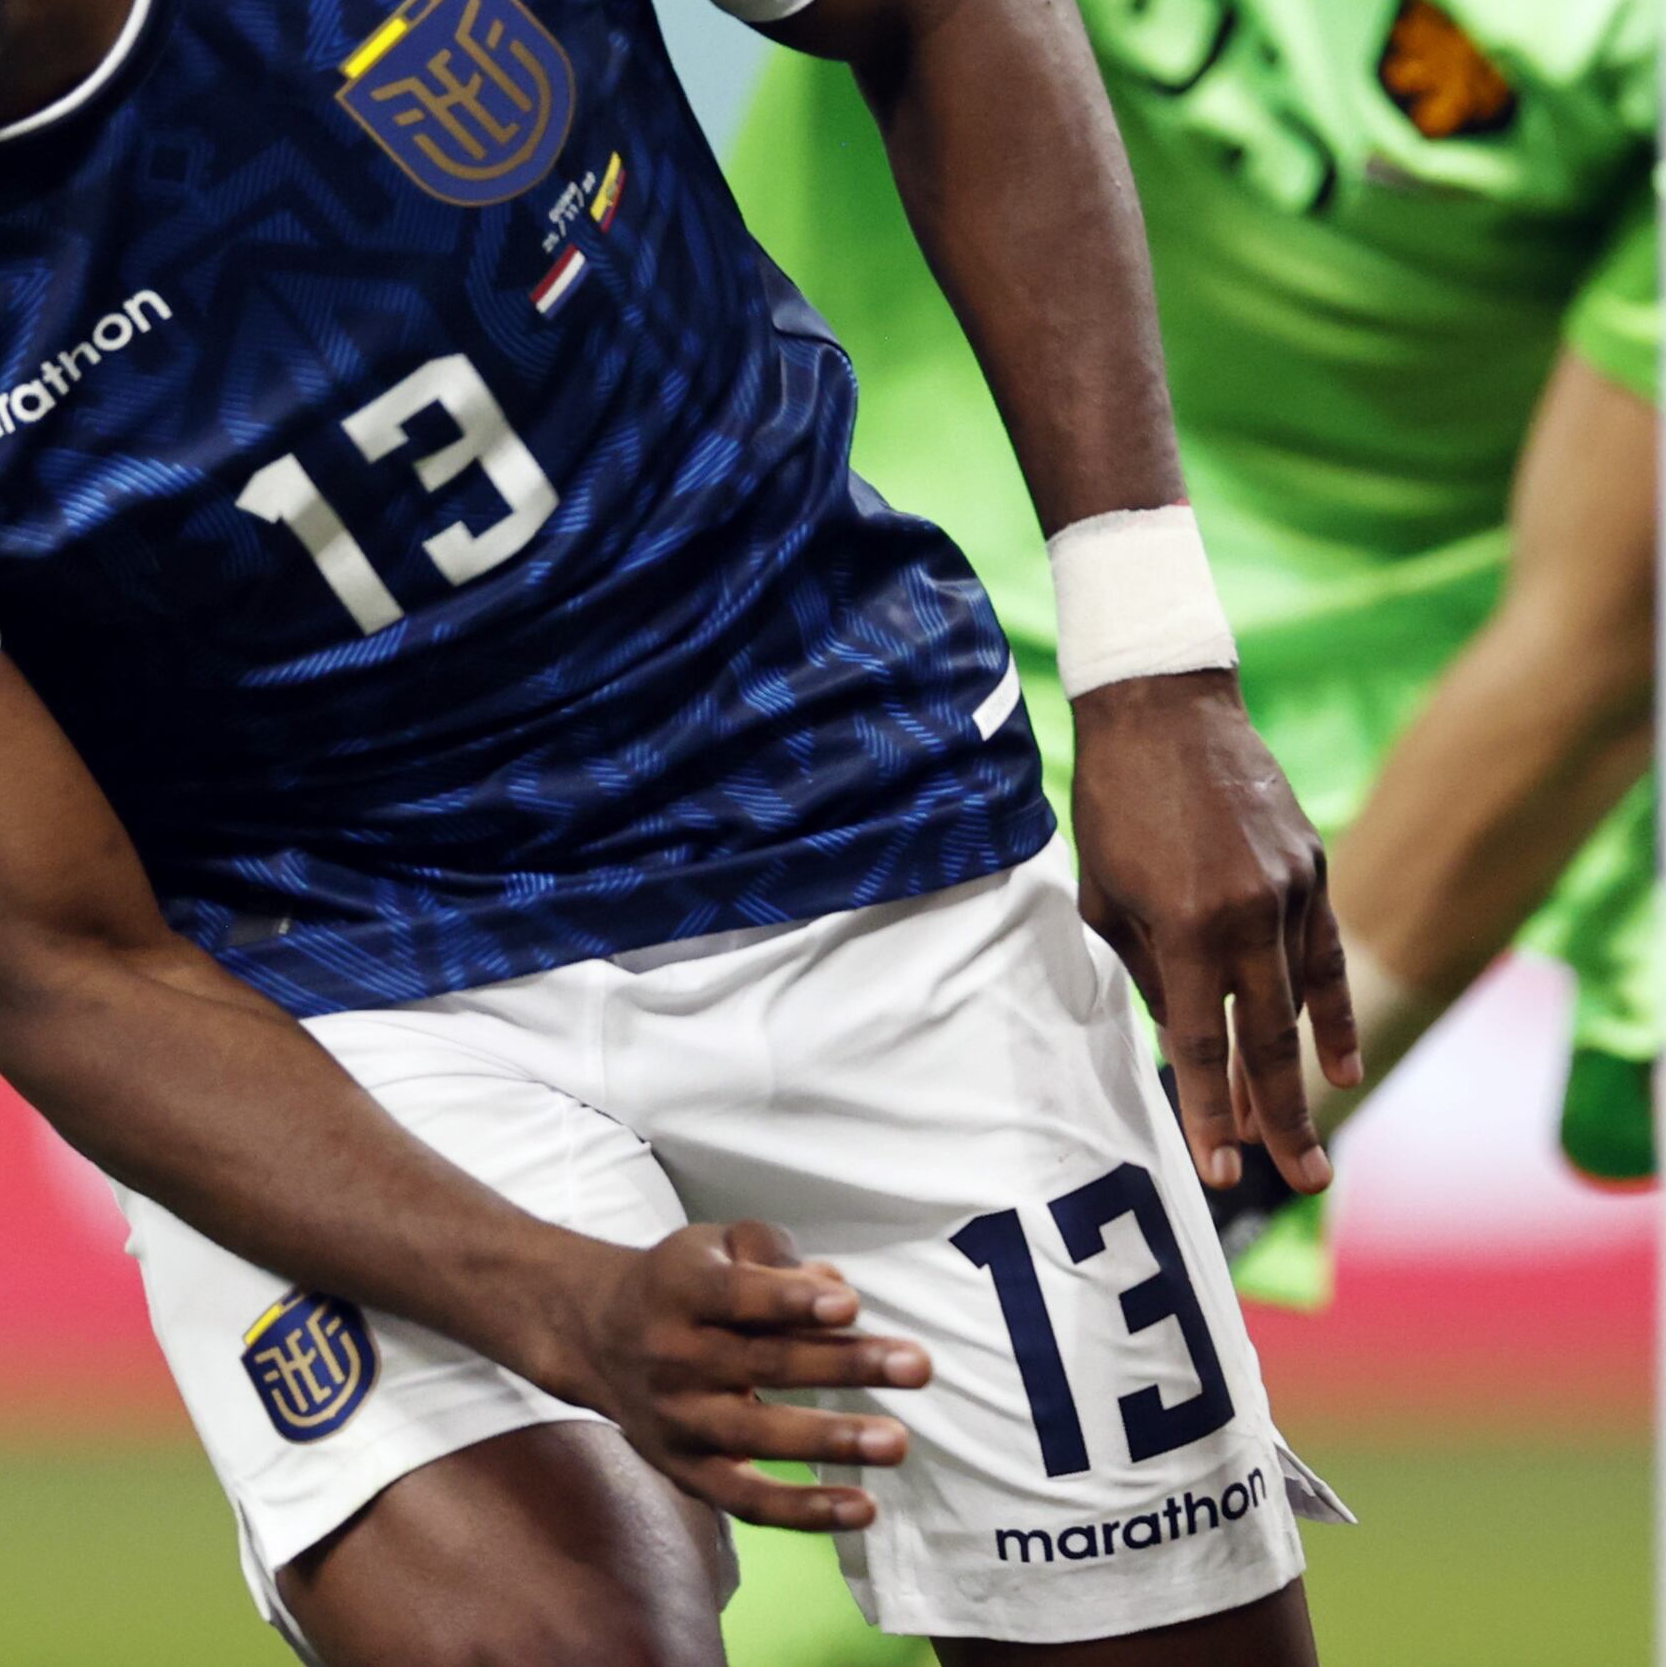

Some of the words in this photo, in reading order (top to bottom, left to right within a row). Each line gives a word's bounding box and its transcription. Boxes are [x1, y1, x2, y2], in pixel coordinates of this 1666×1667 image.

[234, 353, 560, 636] 13
[948, 1161, 1236, 1478] 13
[994, 1466, 1267, 1564] marathon
